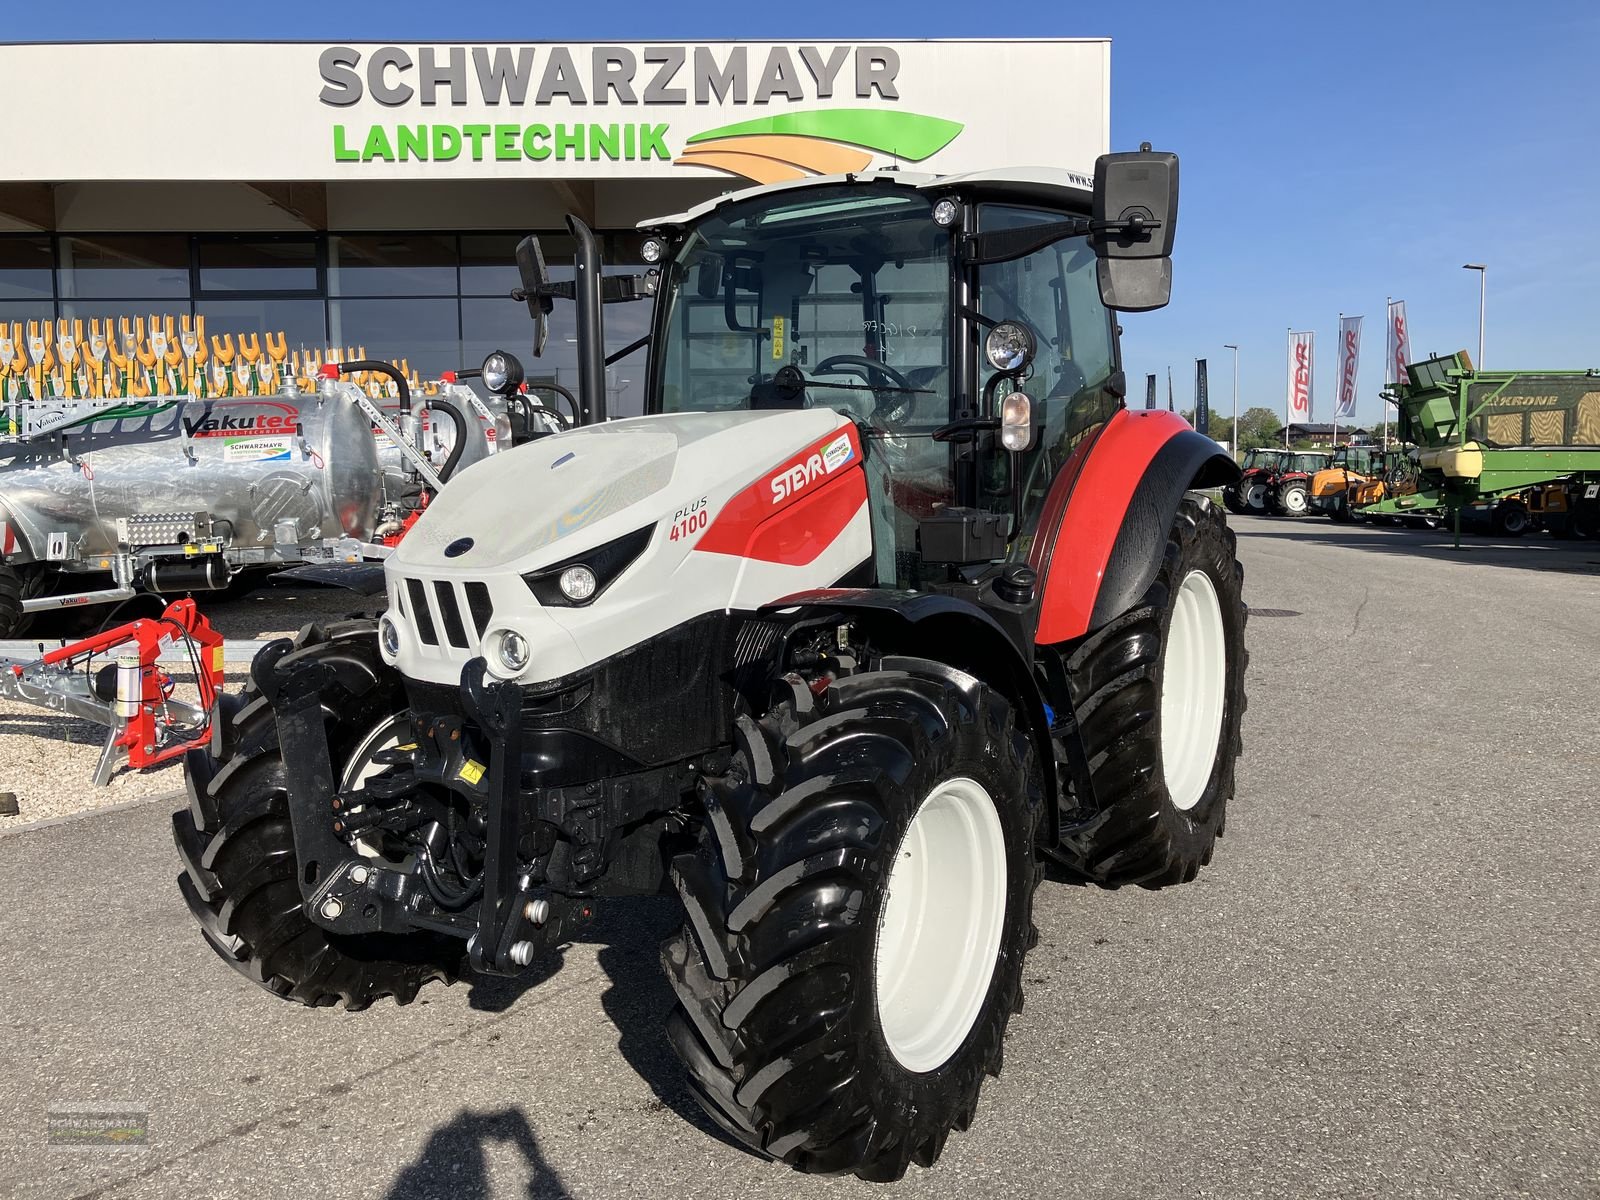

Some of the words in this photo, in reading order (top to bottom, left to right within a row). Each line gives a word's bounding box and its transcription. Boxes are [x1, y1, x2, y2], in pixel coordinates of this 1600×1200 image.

[319, 46, 901, 107] SCHWARZMAYR
[333, 123, 671, 162] LANDTECHNIK
[1294, 343, 1309, 413] STEYR
[1342, 330, 1356, 404] STEYR
[1500, 395, 1558, 407] KRONE
[36, 414, 66, 429] Vakutec
[183, 411, 299, 438] Vakutec
[230, 442, 283, 451] SCHWARZMAYR
[770, 453, 825, 504] STEYR
[674, 495, 708, 522] PLUS
[669, 510, 708, 542] 4100
